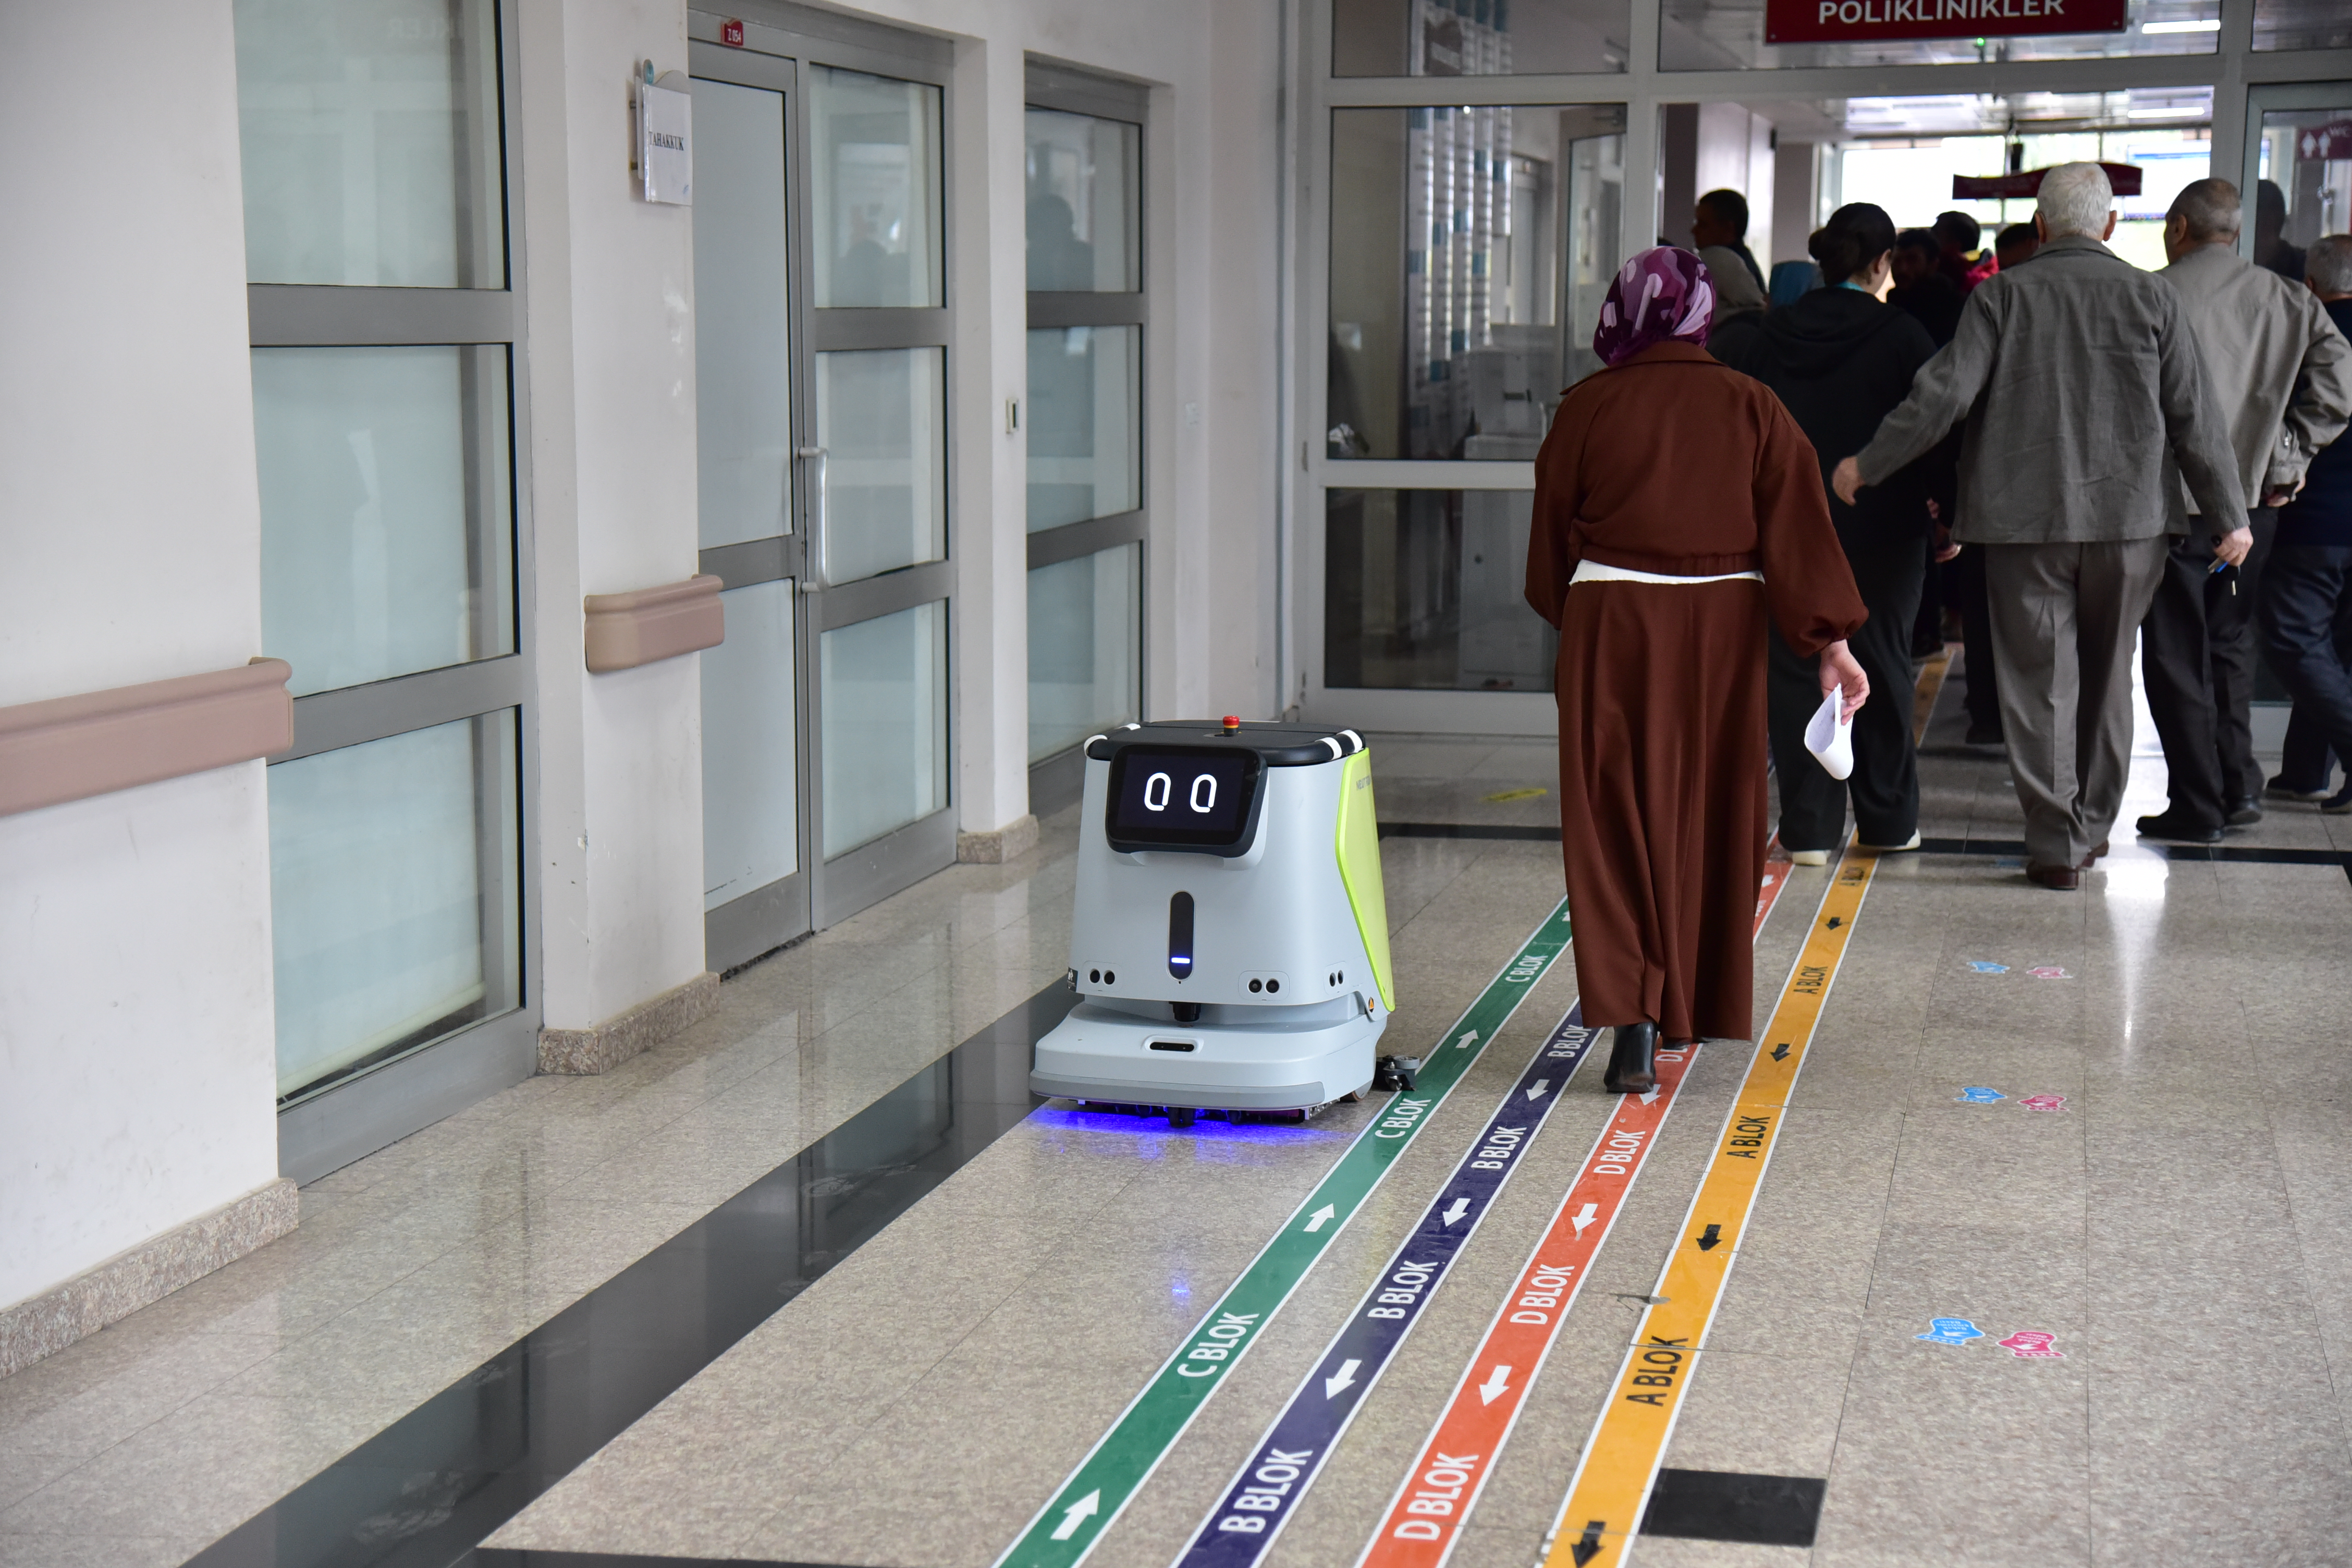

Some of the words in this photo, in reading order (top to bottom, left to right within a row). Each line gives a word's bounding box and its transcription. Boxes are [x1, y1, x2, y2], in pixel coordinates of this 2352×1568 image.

[1819, 0, 2065, 24] POLIKLINIKLER
[648, 131, 684, 151] TAHAKKUK
[1510, 955, 1549, 975] BLOK
[1796, 966, 1828, 987] BLOK
[1553, 1024, 1592, 1049] BLOK
[1381, 1098, 1431, 1128] BLOK
[1375, 1130, 1406, 1138] C
[1478, 1126, 1527, 1158] BLOK
[1730, 1116, 1770, 1147] BLOK
[1600, 1130, 1646, 1162] BLOK
[1726, 1150, 1758, 1159] A
[1471, 1160, 1503, 1169] B
[1593, 1165, 1626, 1174] D
[1377, 1260, 1439, 1304] BLOK
[1519, 1264, 1575, 1308] BLOK
[1367, 1307, 1406, 1319] B
[1510, 1310, 1548, 1325] D
[1188, 1312, 1260, 1361] BLOK
[1177, 1364, 1218, 1377] C
[1632, 1336, 1689, 1387] BLOK
[1625, 1393, 1668, 1407] A
[1233, 1448, 1313, 1511] BLOK
[1407, 1452, 1479, 1516] BLOK
[1218, 1516, 1266, 1533] B
[1393, 1520, 1441, 1541] D
